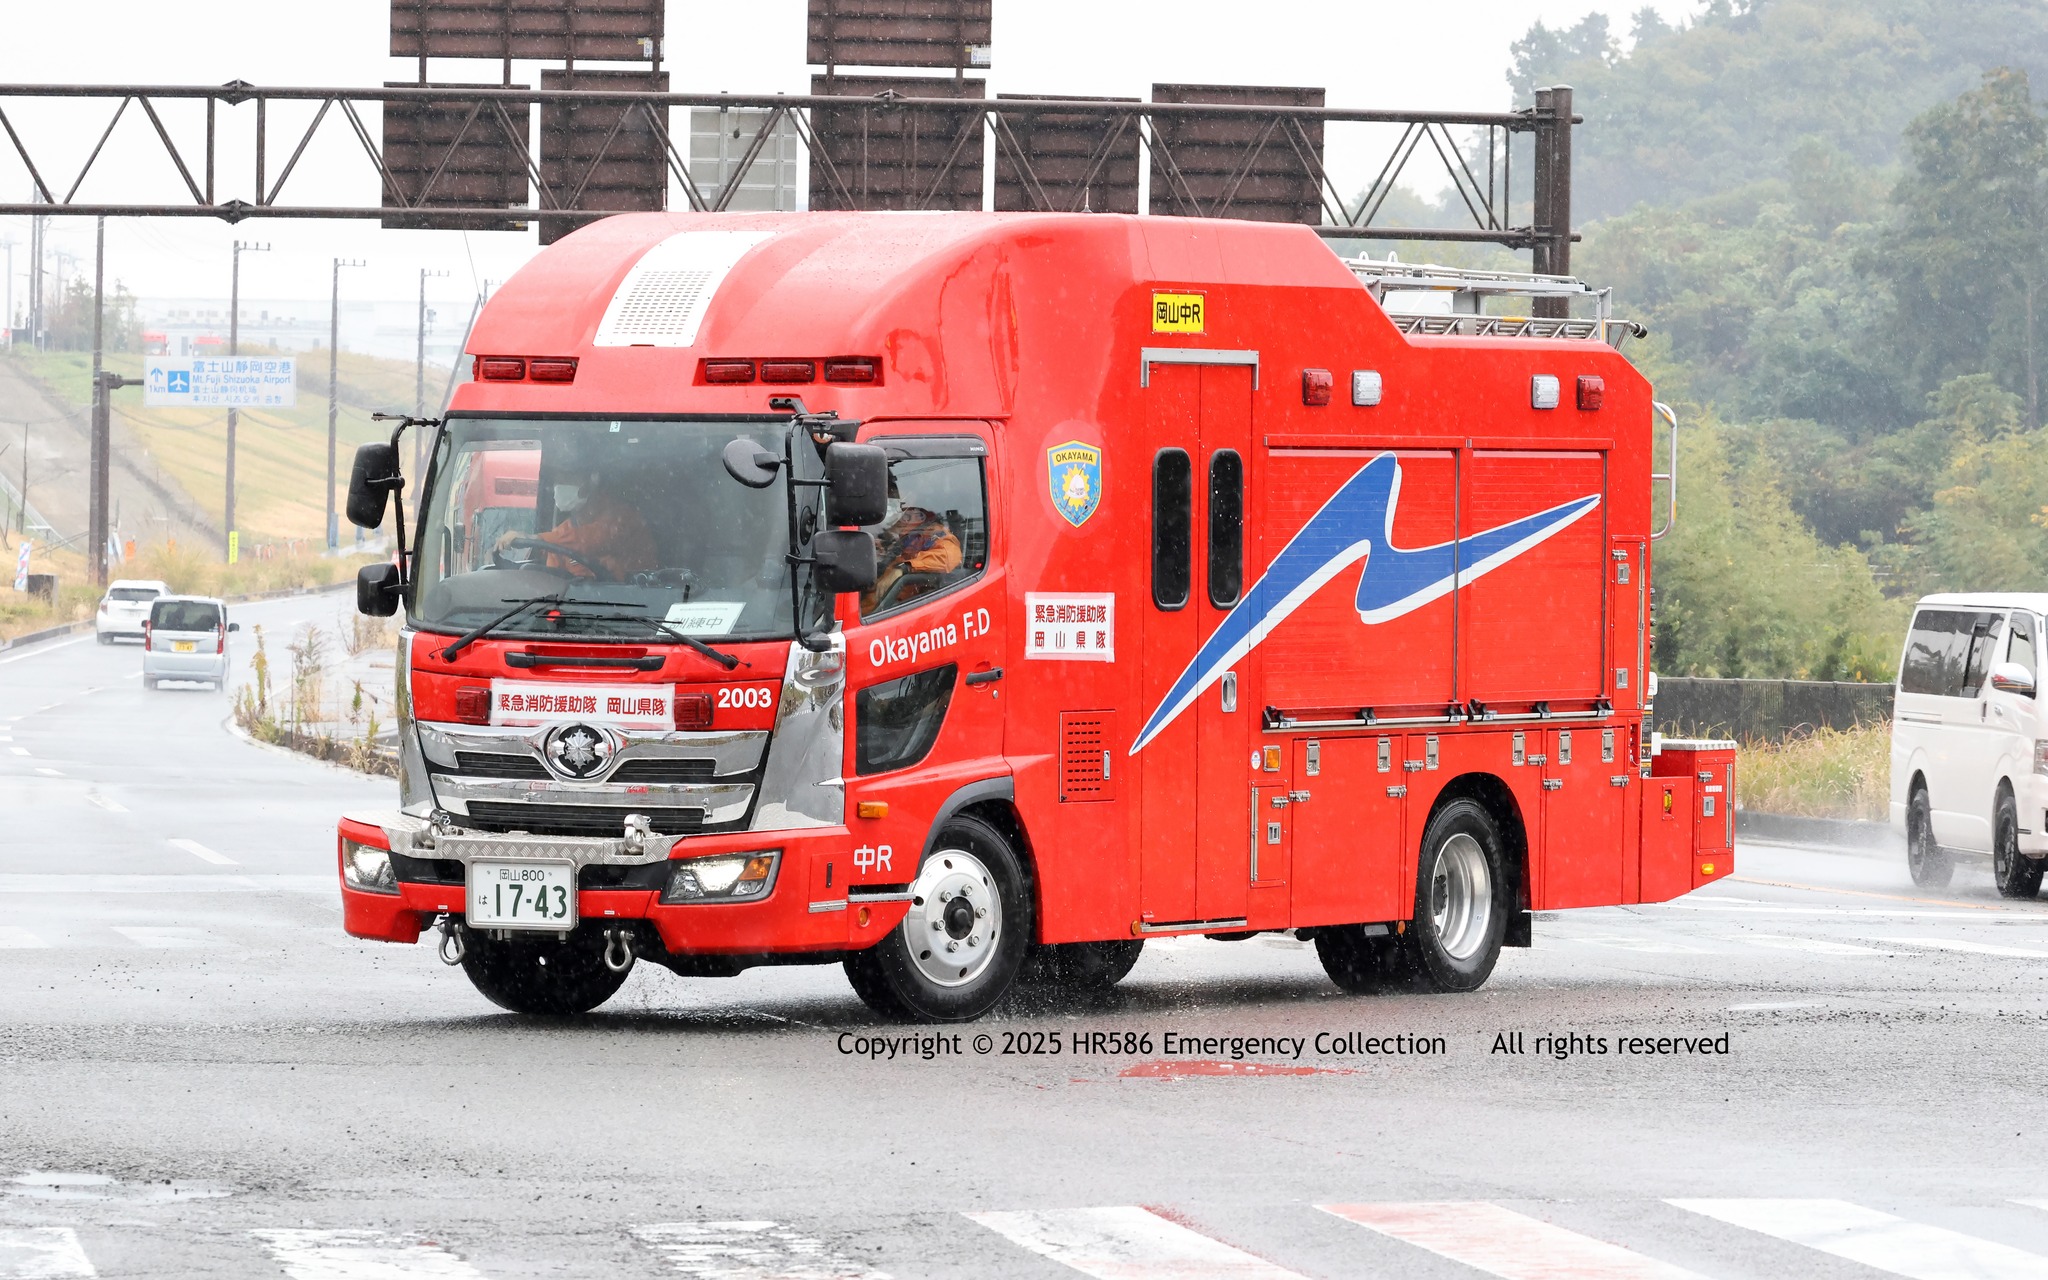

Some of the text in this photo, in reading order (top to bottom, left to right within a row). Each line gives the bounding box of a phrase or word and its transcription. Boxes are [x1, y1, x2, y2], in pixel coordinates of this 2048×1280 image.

[1156, 301, 1201, 325] 岡山中R
[192, 360, 291, 374] 富士山静岡空港
[205, 375, 221, 385] Fuji
[223, 375, 260, 384] Shizuoka
[263, 375, 291, 385] Airport
[1055, 451, 1094, 463] OKAYAMA
[1035, 604, 1107, 623] 緊急消防援助隊
[869, 623, 957, 667] Okayama
[498, 693, 668, 717] 緊急消防援助隊 岡山県隊
[717, 687, 772, 709] 2003
[853, 844, 893, 875] 中R
[495, 883, 567, 919] 17-43
